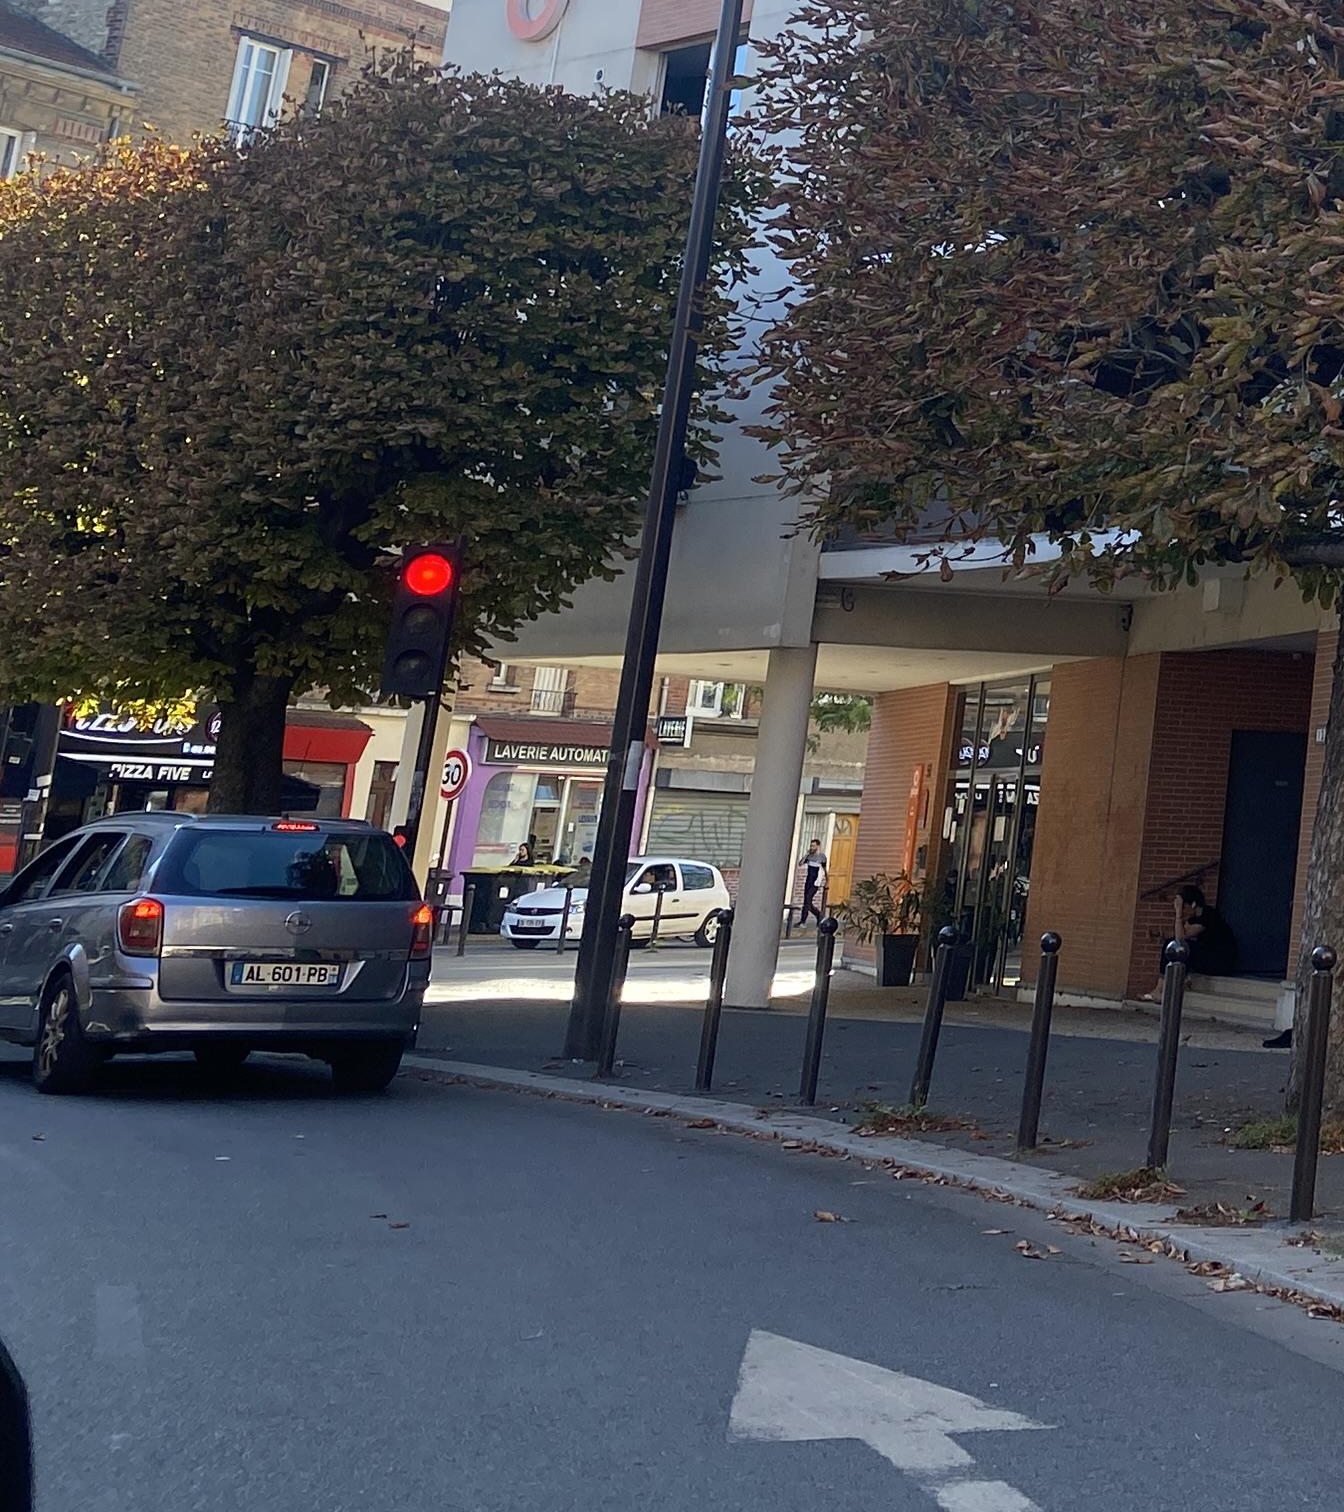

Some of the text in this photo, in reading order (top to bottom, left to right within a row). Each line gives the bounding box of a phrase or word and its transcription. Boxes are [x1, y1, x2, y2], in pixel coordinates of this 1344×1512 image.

[495, 745, 610, 763] LAVERIE AUTOMAT
[157, 766, 192, 781] FIVE
[442, 764, 461, 785] 30
